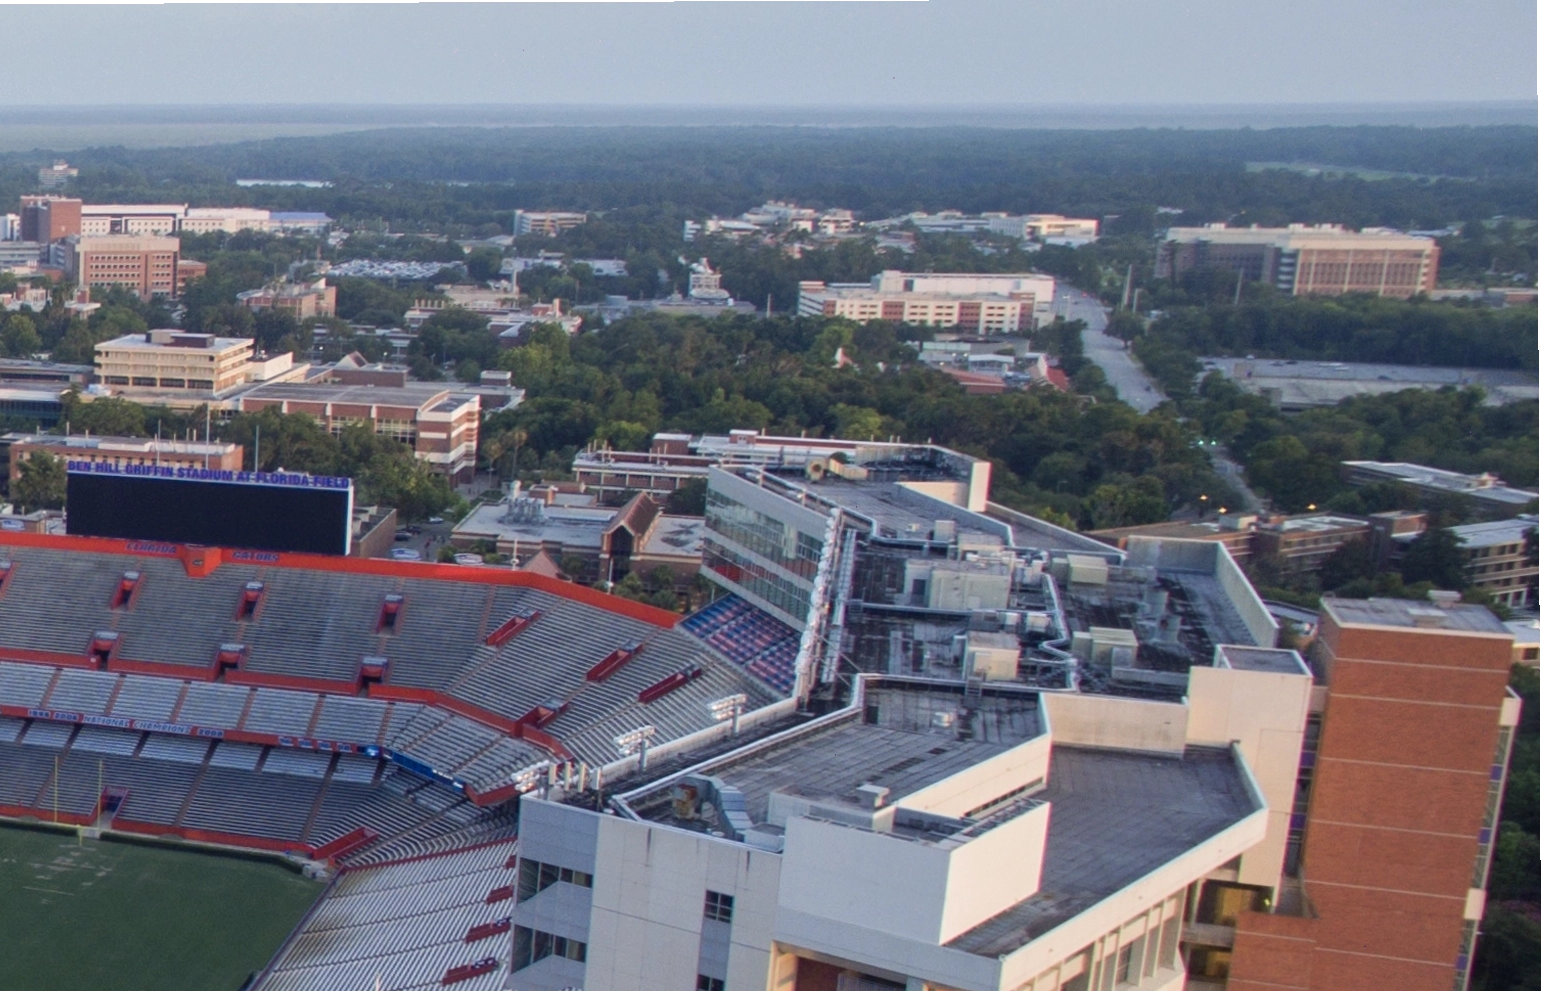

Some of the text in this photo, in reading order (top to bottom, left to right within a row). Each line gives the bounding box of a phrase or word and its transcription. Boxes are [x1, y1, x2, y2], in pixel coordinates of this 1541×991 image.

[68, 460, 350, 489] BEN HILL GRIFFIN STADIUM AT FLORIDA FIELD
[83, 715, 130, 728] NATIONAL
[133, 721, 193, 735] CHAMPIONS
